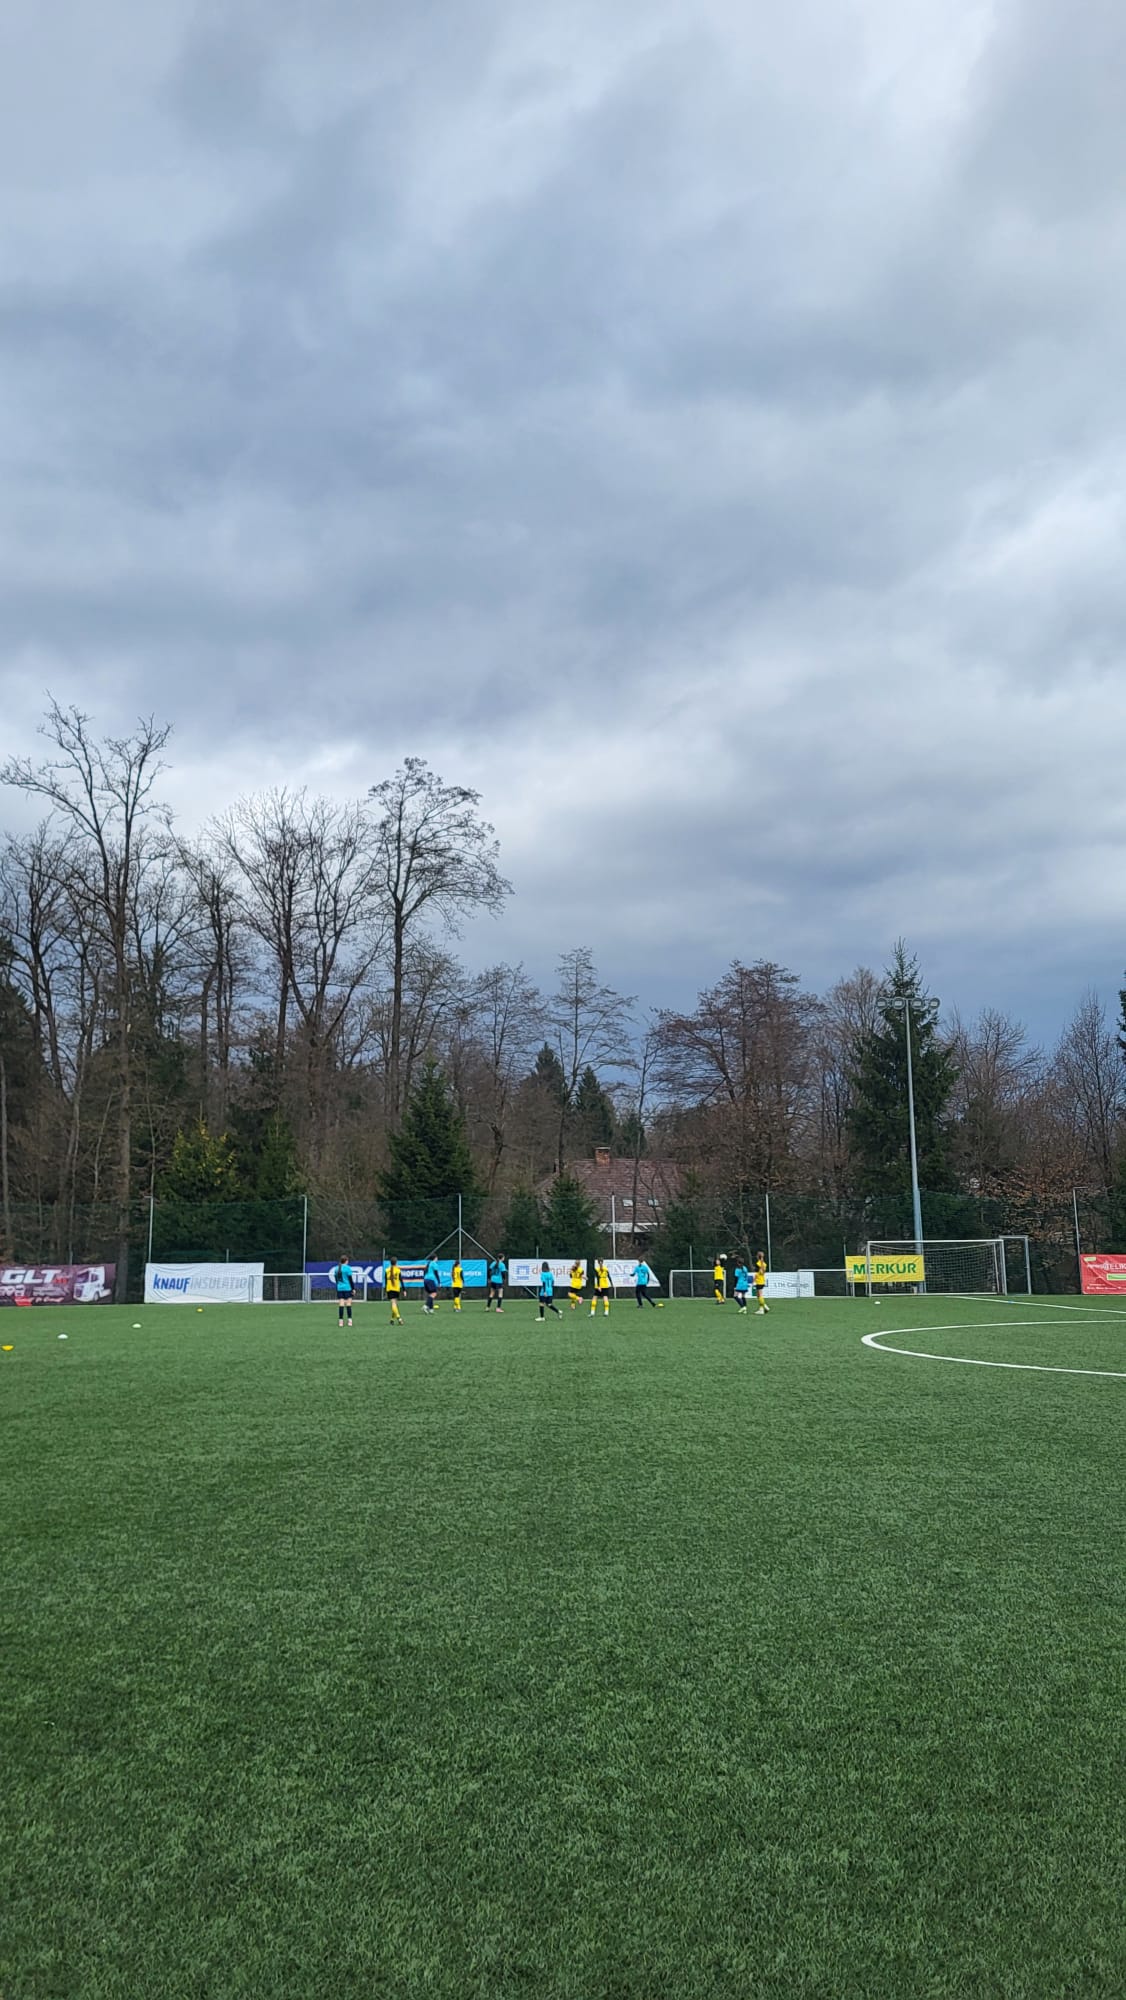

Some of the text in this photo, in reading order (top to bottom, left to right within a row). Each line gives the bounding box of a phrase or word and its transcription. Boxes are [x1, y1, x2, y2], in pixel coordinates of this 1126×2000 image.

[0, 1269, 62, 1285] GLT
[853, 1263, 917, 1275] MERKUR
[153, 1274, 254, 1293] KNAUF INSULATIO
